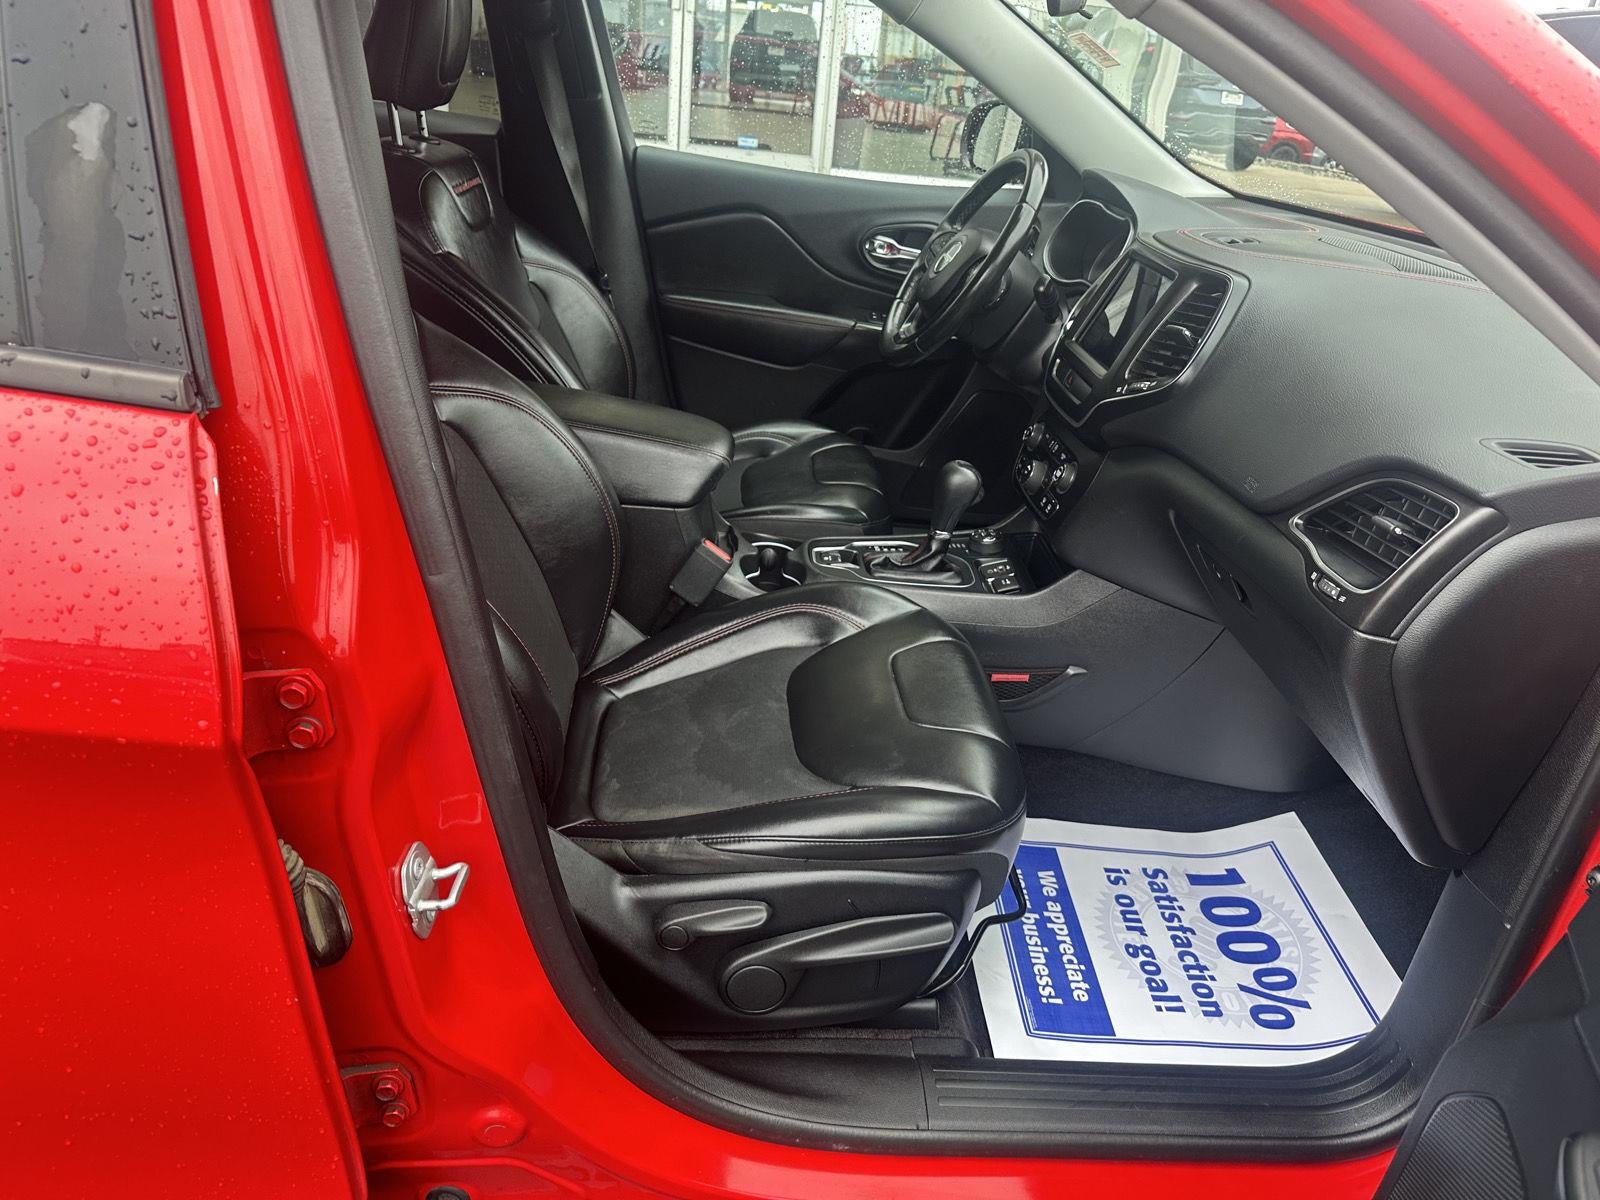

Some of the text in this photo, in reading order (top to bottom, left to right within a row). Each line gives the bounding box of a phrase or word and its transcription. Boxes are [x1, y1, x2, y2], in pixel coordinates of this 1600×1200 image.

[1103, 867, 1130, 887] is
[1114, 893, 1147, 937] our
[1022, 911, 1064, 1005] business!
[1037, 870, 1091, 1002] We appreciate
[1124, 943, 1185, 1013] goal!
[1141, 867, 1224, 1018] Satisfaction
[1186, 867, 1312, 1030] 100%
